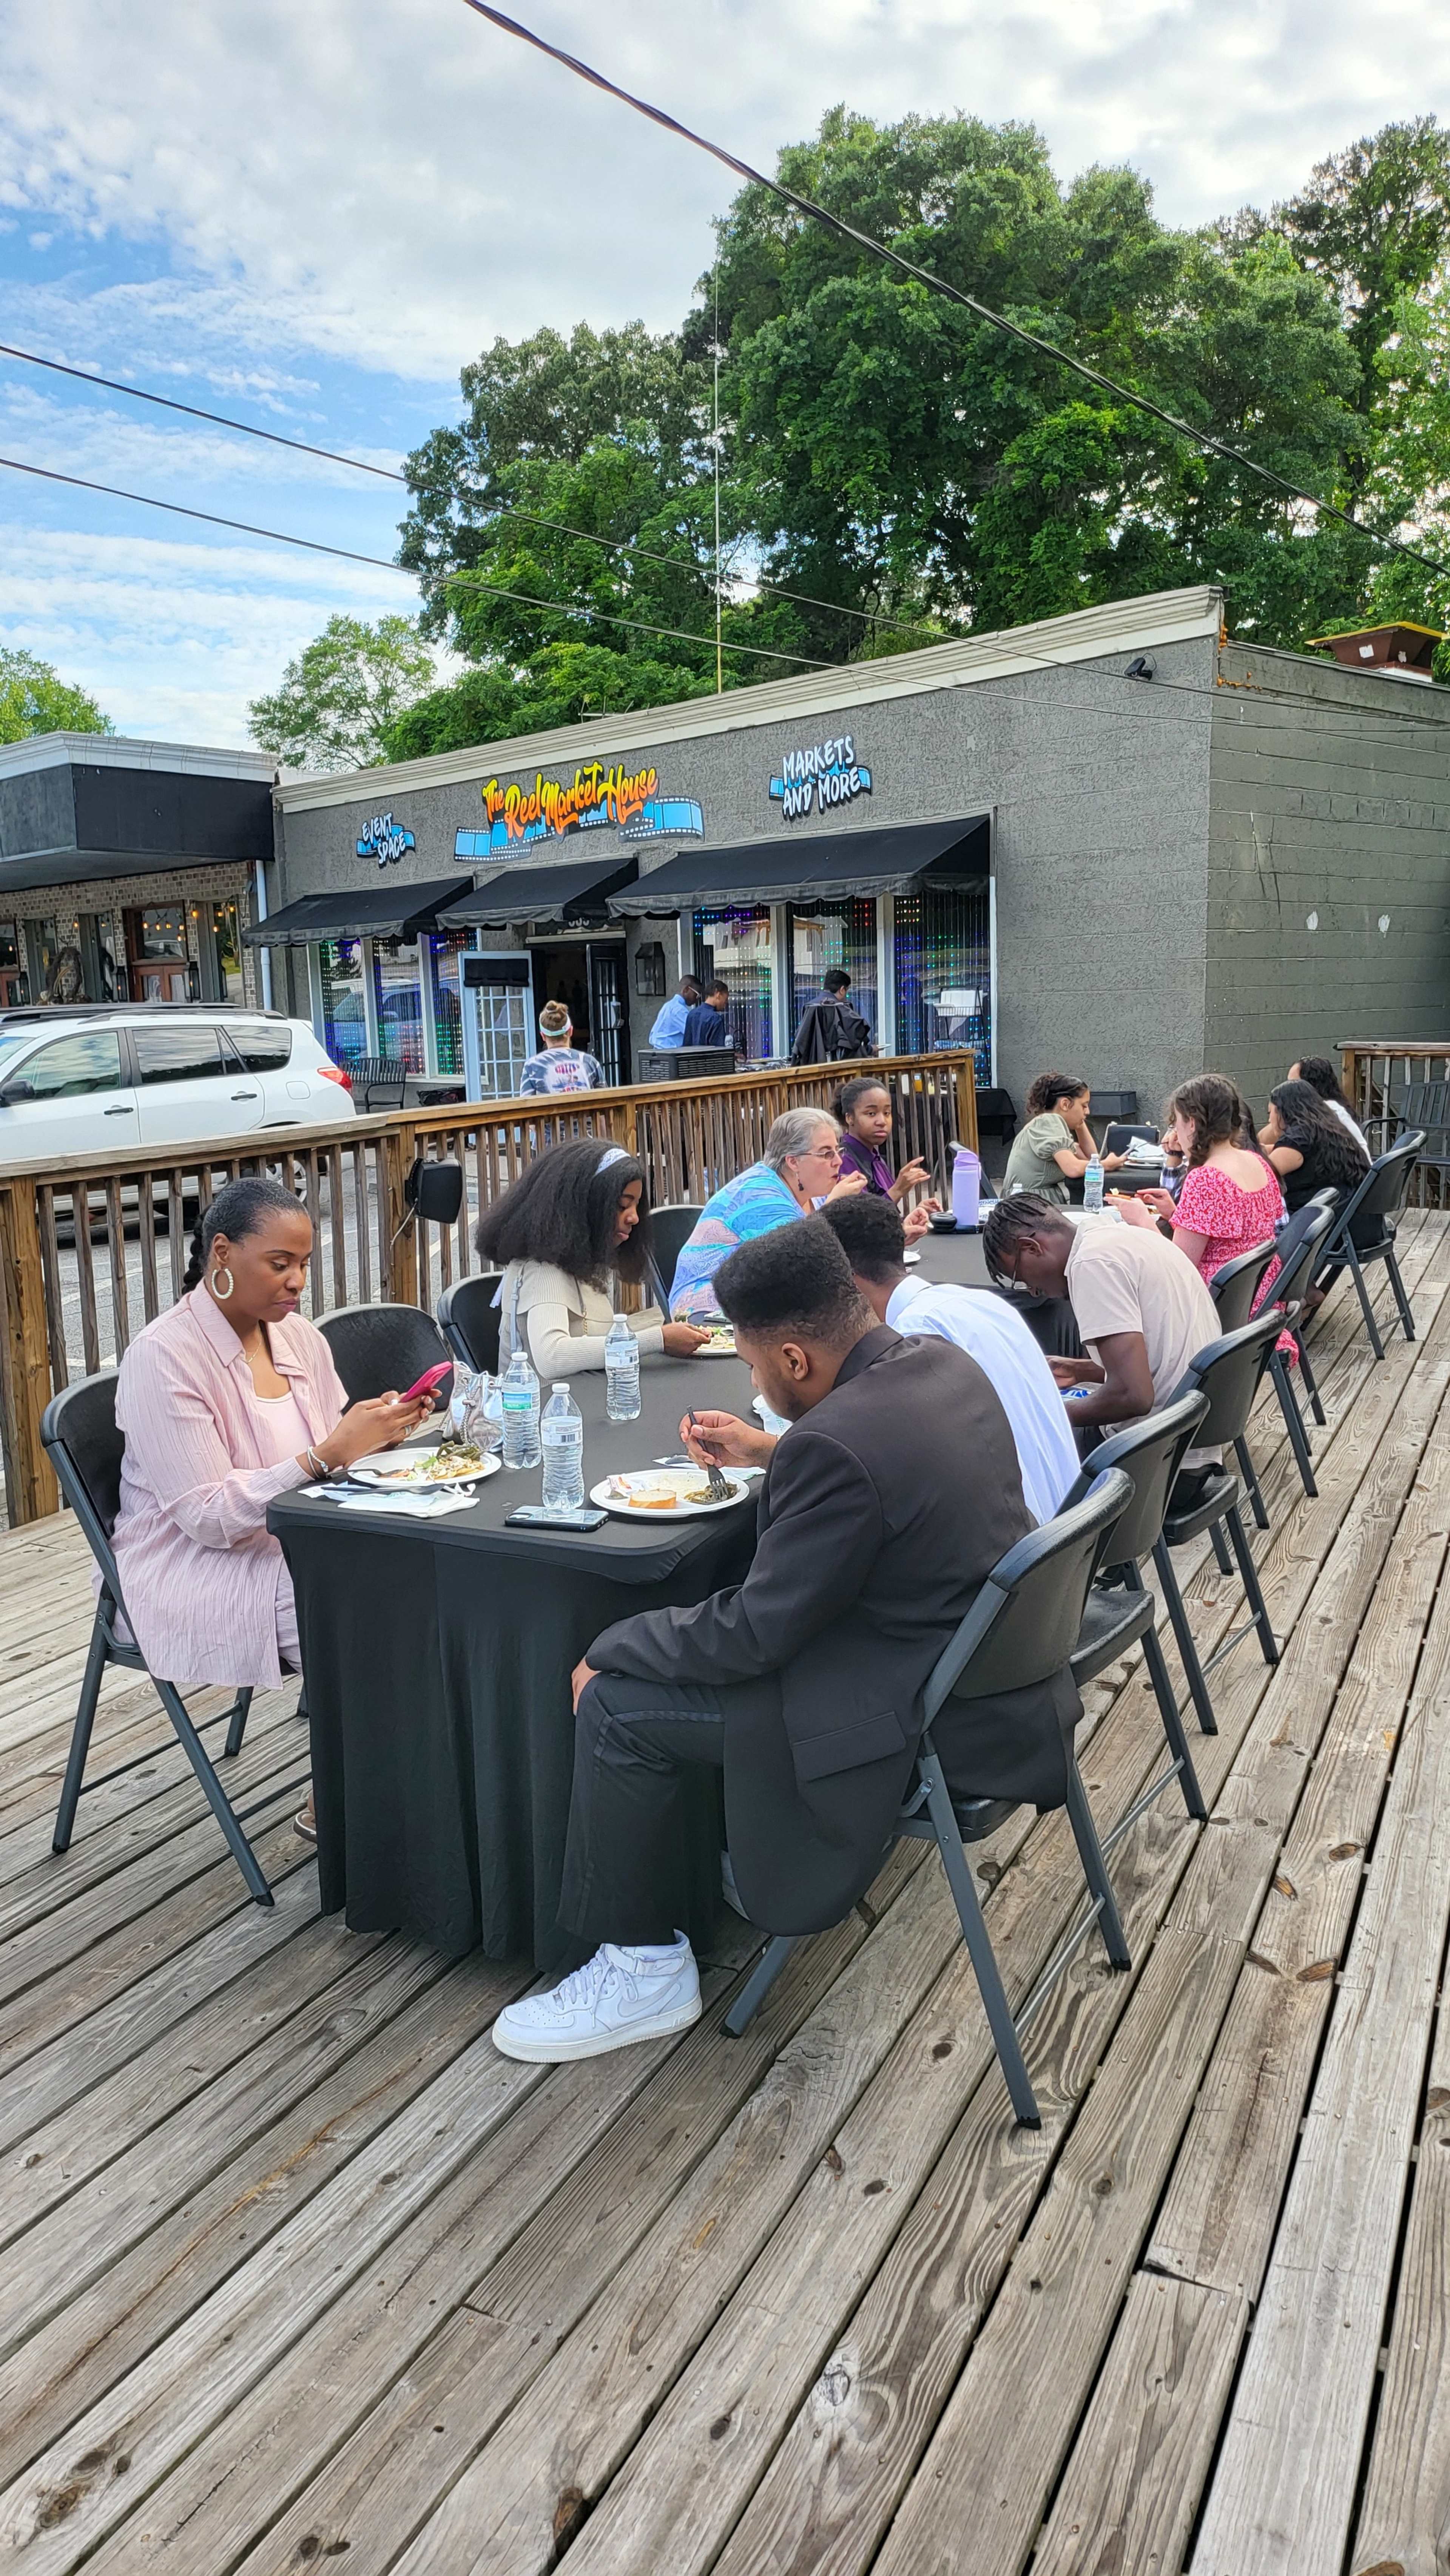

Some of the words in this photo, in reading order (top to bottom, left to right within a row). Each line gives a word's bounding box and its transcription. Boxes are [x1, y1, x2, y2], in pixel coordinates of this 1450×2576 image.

[783, 736, 854, 786] MARKETS
[483, 779, 504, 822] The
[504, 773, 541, 839] Reel
[597, 764, 658, 824] House
[783, 783, 812, 816] AND
[818, 766, 861, 809] MORE
[362, 812, 392, 844] EVENT
[378, 832, 406, 864] SPACE
